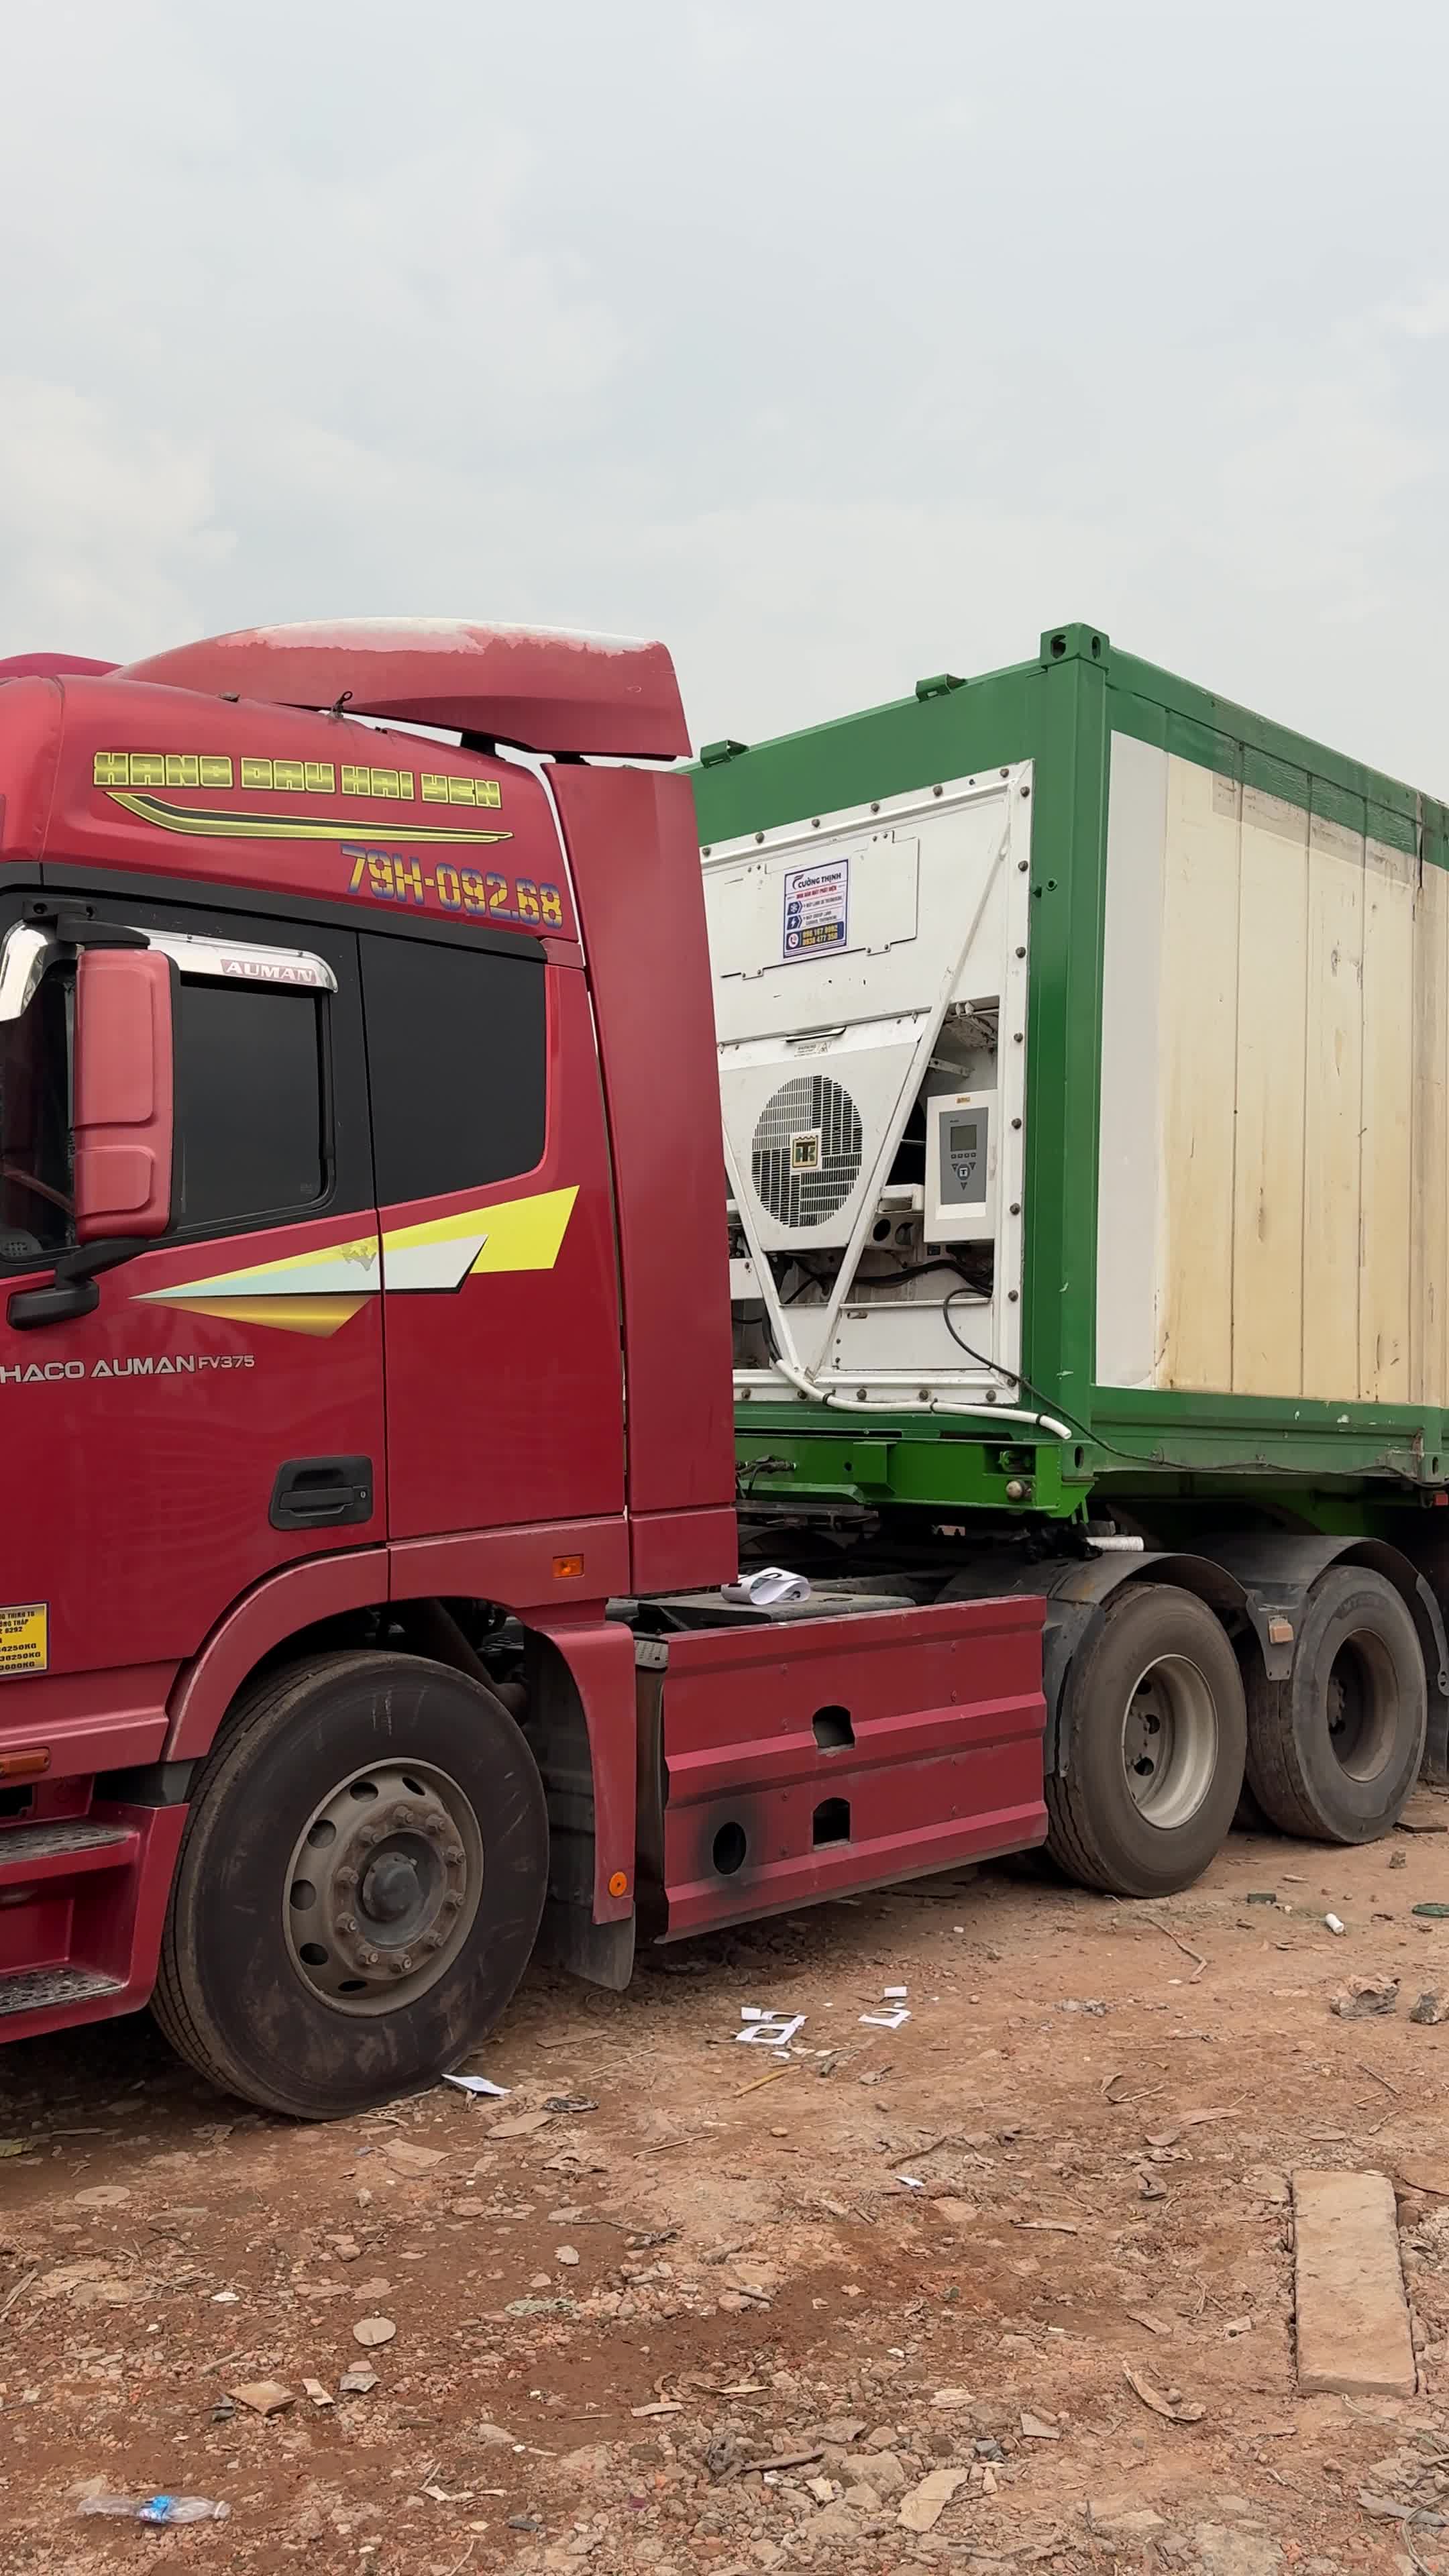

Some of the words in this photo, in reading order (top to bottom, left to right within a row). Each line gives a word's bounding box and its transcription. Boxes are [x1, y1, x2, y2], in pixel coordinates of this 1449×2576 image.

[341, 843, 564, 929] 79H-092.68
[225, 961, 313, 982] AUMAN
[91, 1355, 195, 1378] AUMAN
[198, 1355, 255, 1370] FV375
